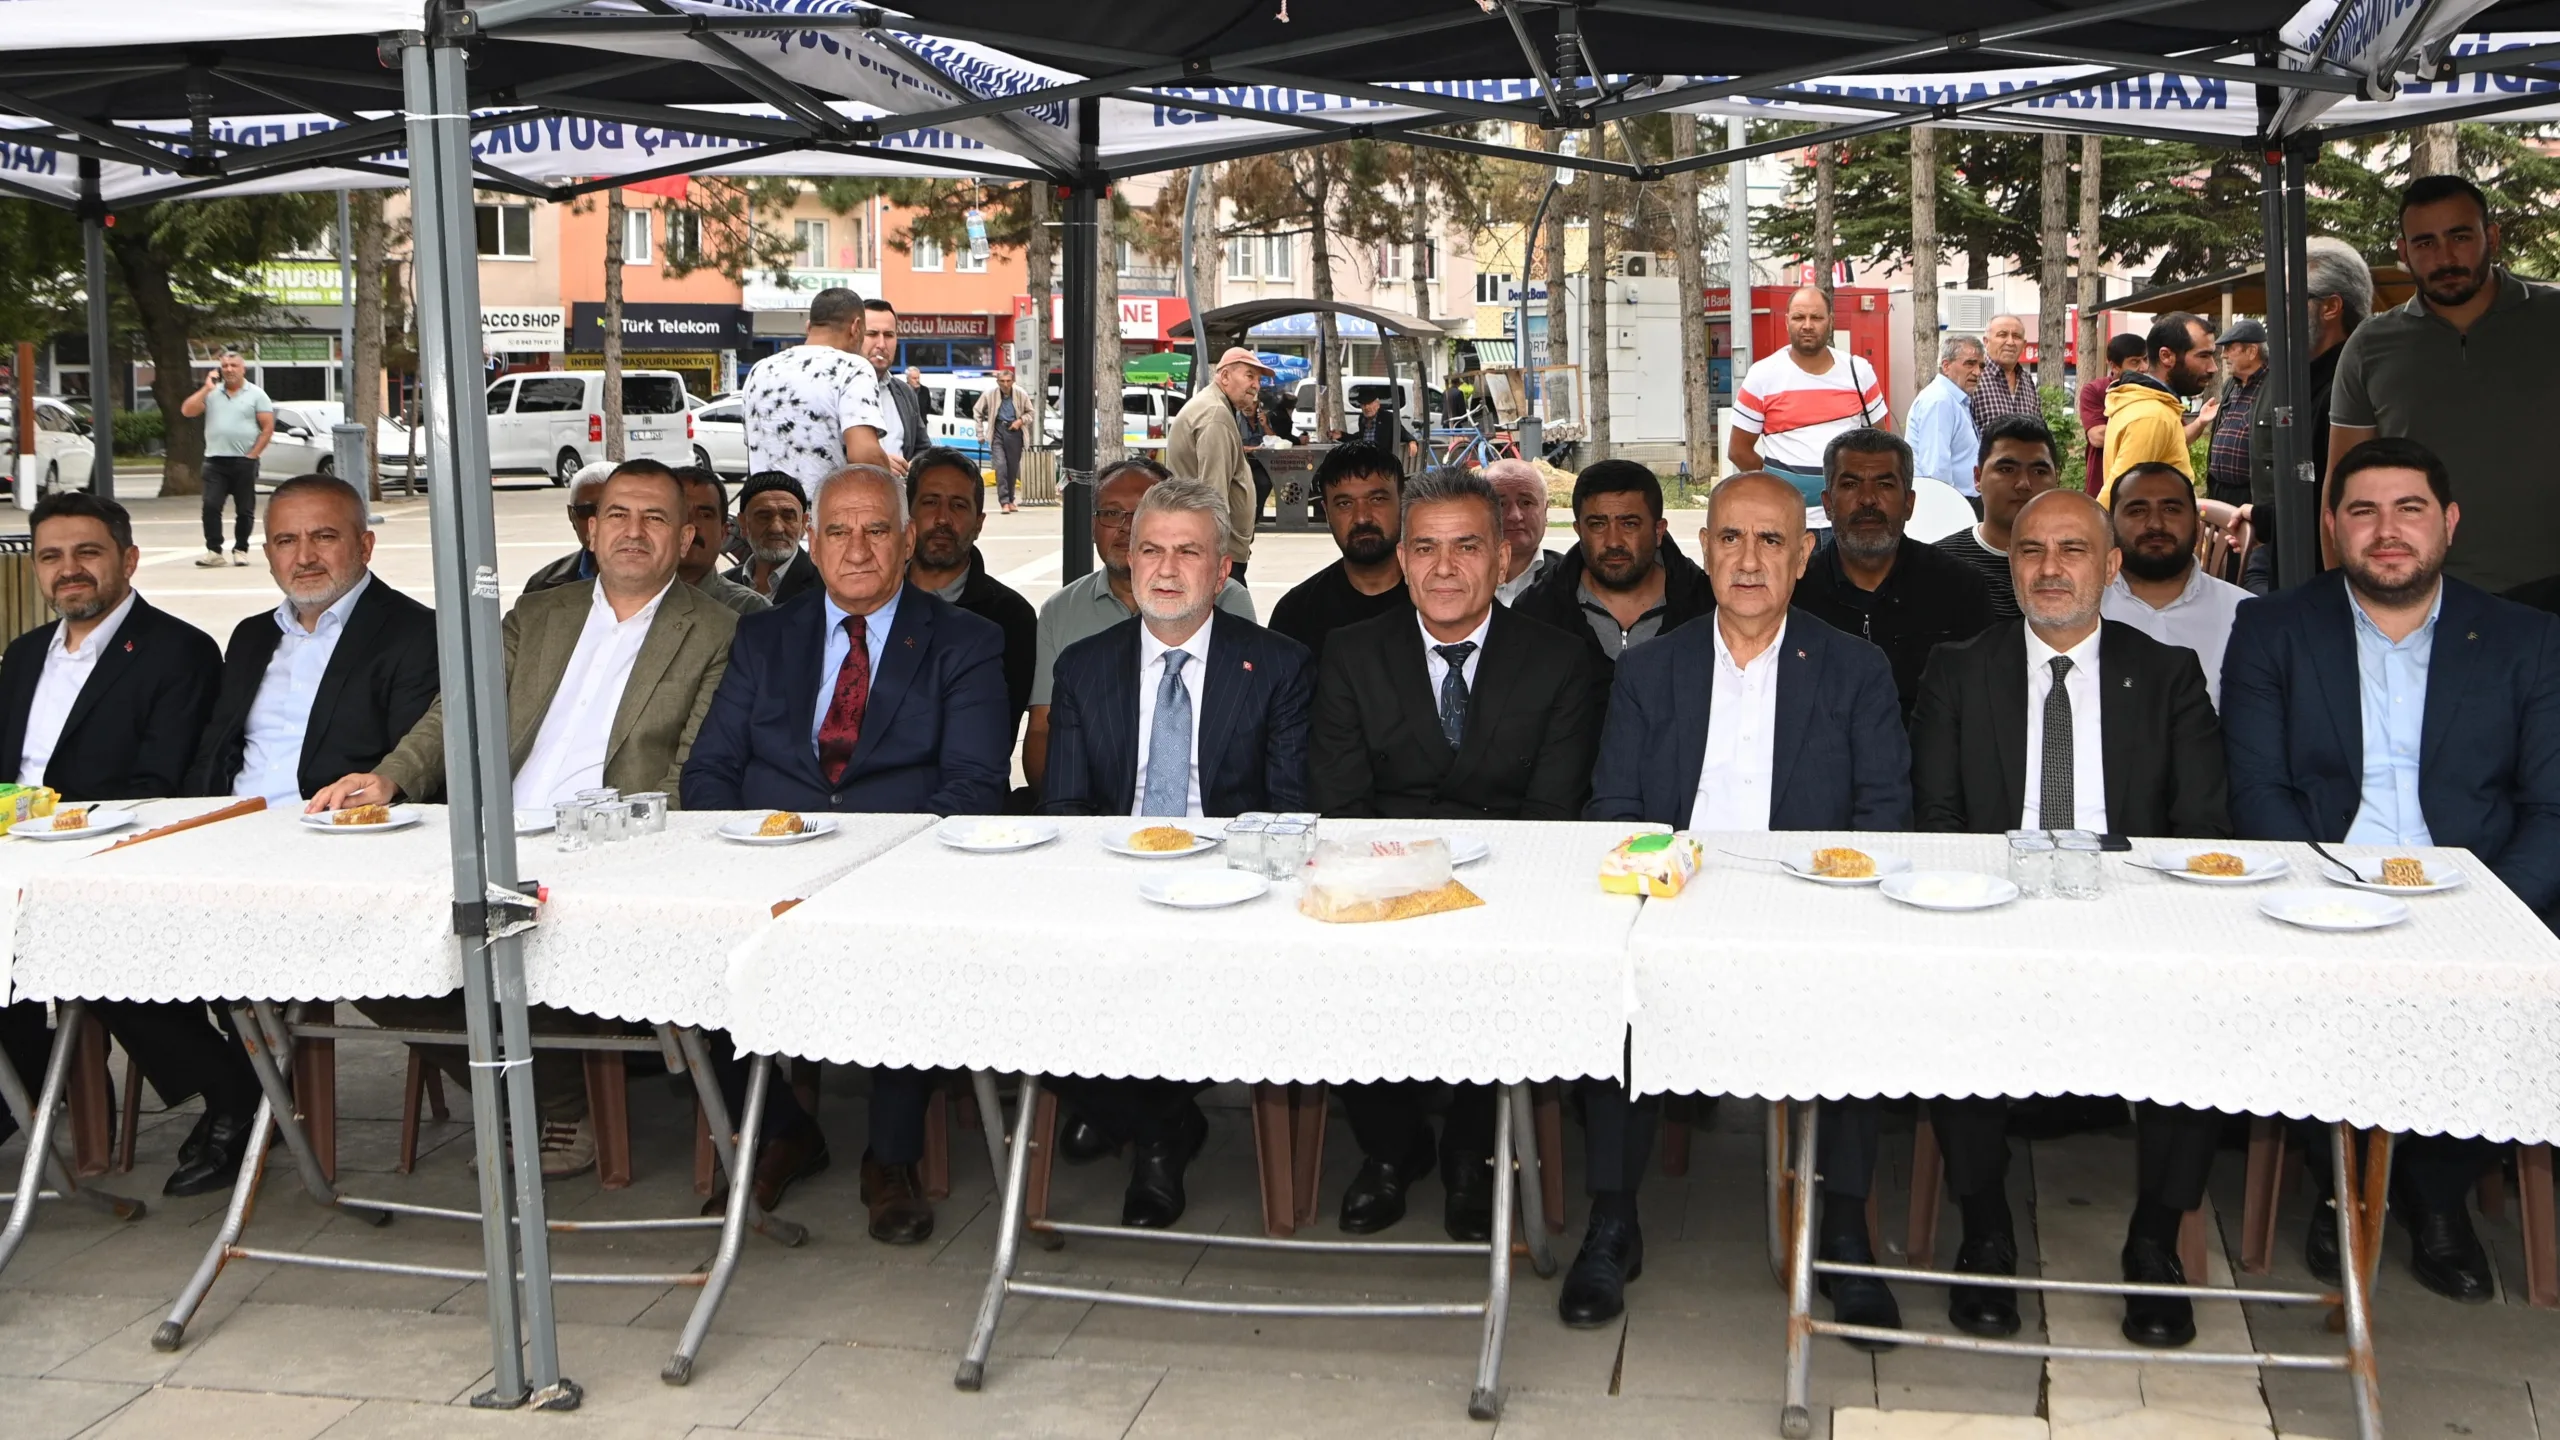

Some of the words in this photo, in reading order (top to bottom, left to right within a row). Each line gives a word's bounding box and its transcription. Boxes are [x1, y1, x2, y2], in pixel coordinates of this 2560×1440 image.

[481, 314, 520, 327] ACCO
[522, 314, 560, 327] SHOP
[622, 318, 653, 334] Türk
[657, 318, 720, 334] Telekom
[896, 317, 933, 334] ROĞLU
[937, 317, 984, 334] MARKET
[622, 358, 670, 367] BAŞVURU
[672, 358, 714, 366] NOKTASI
